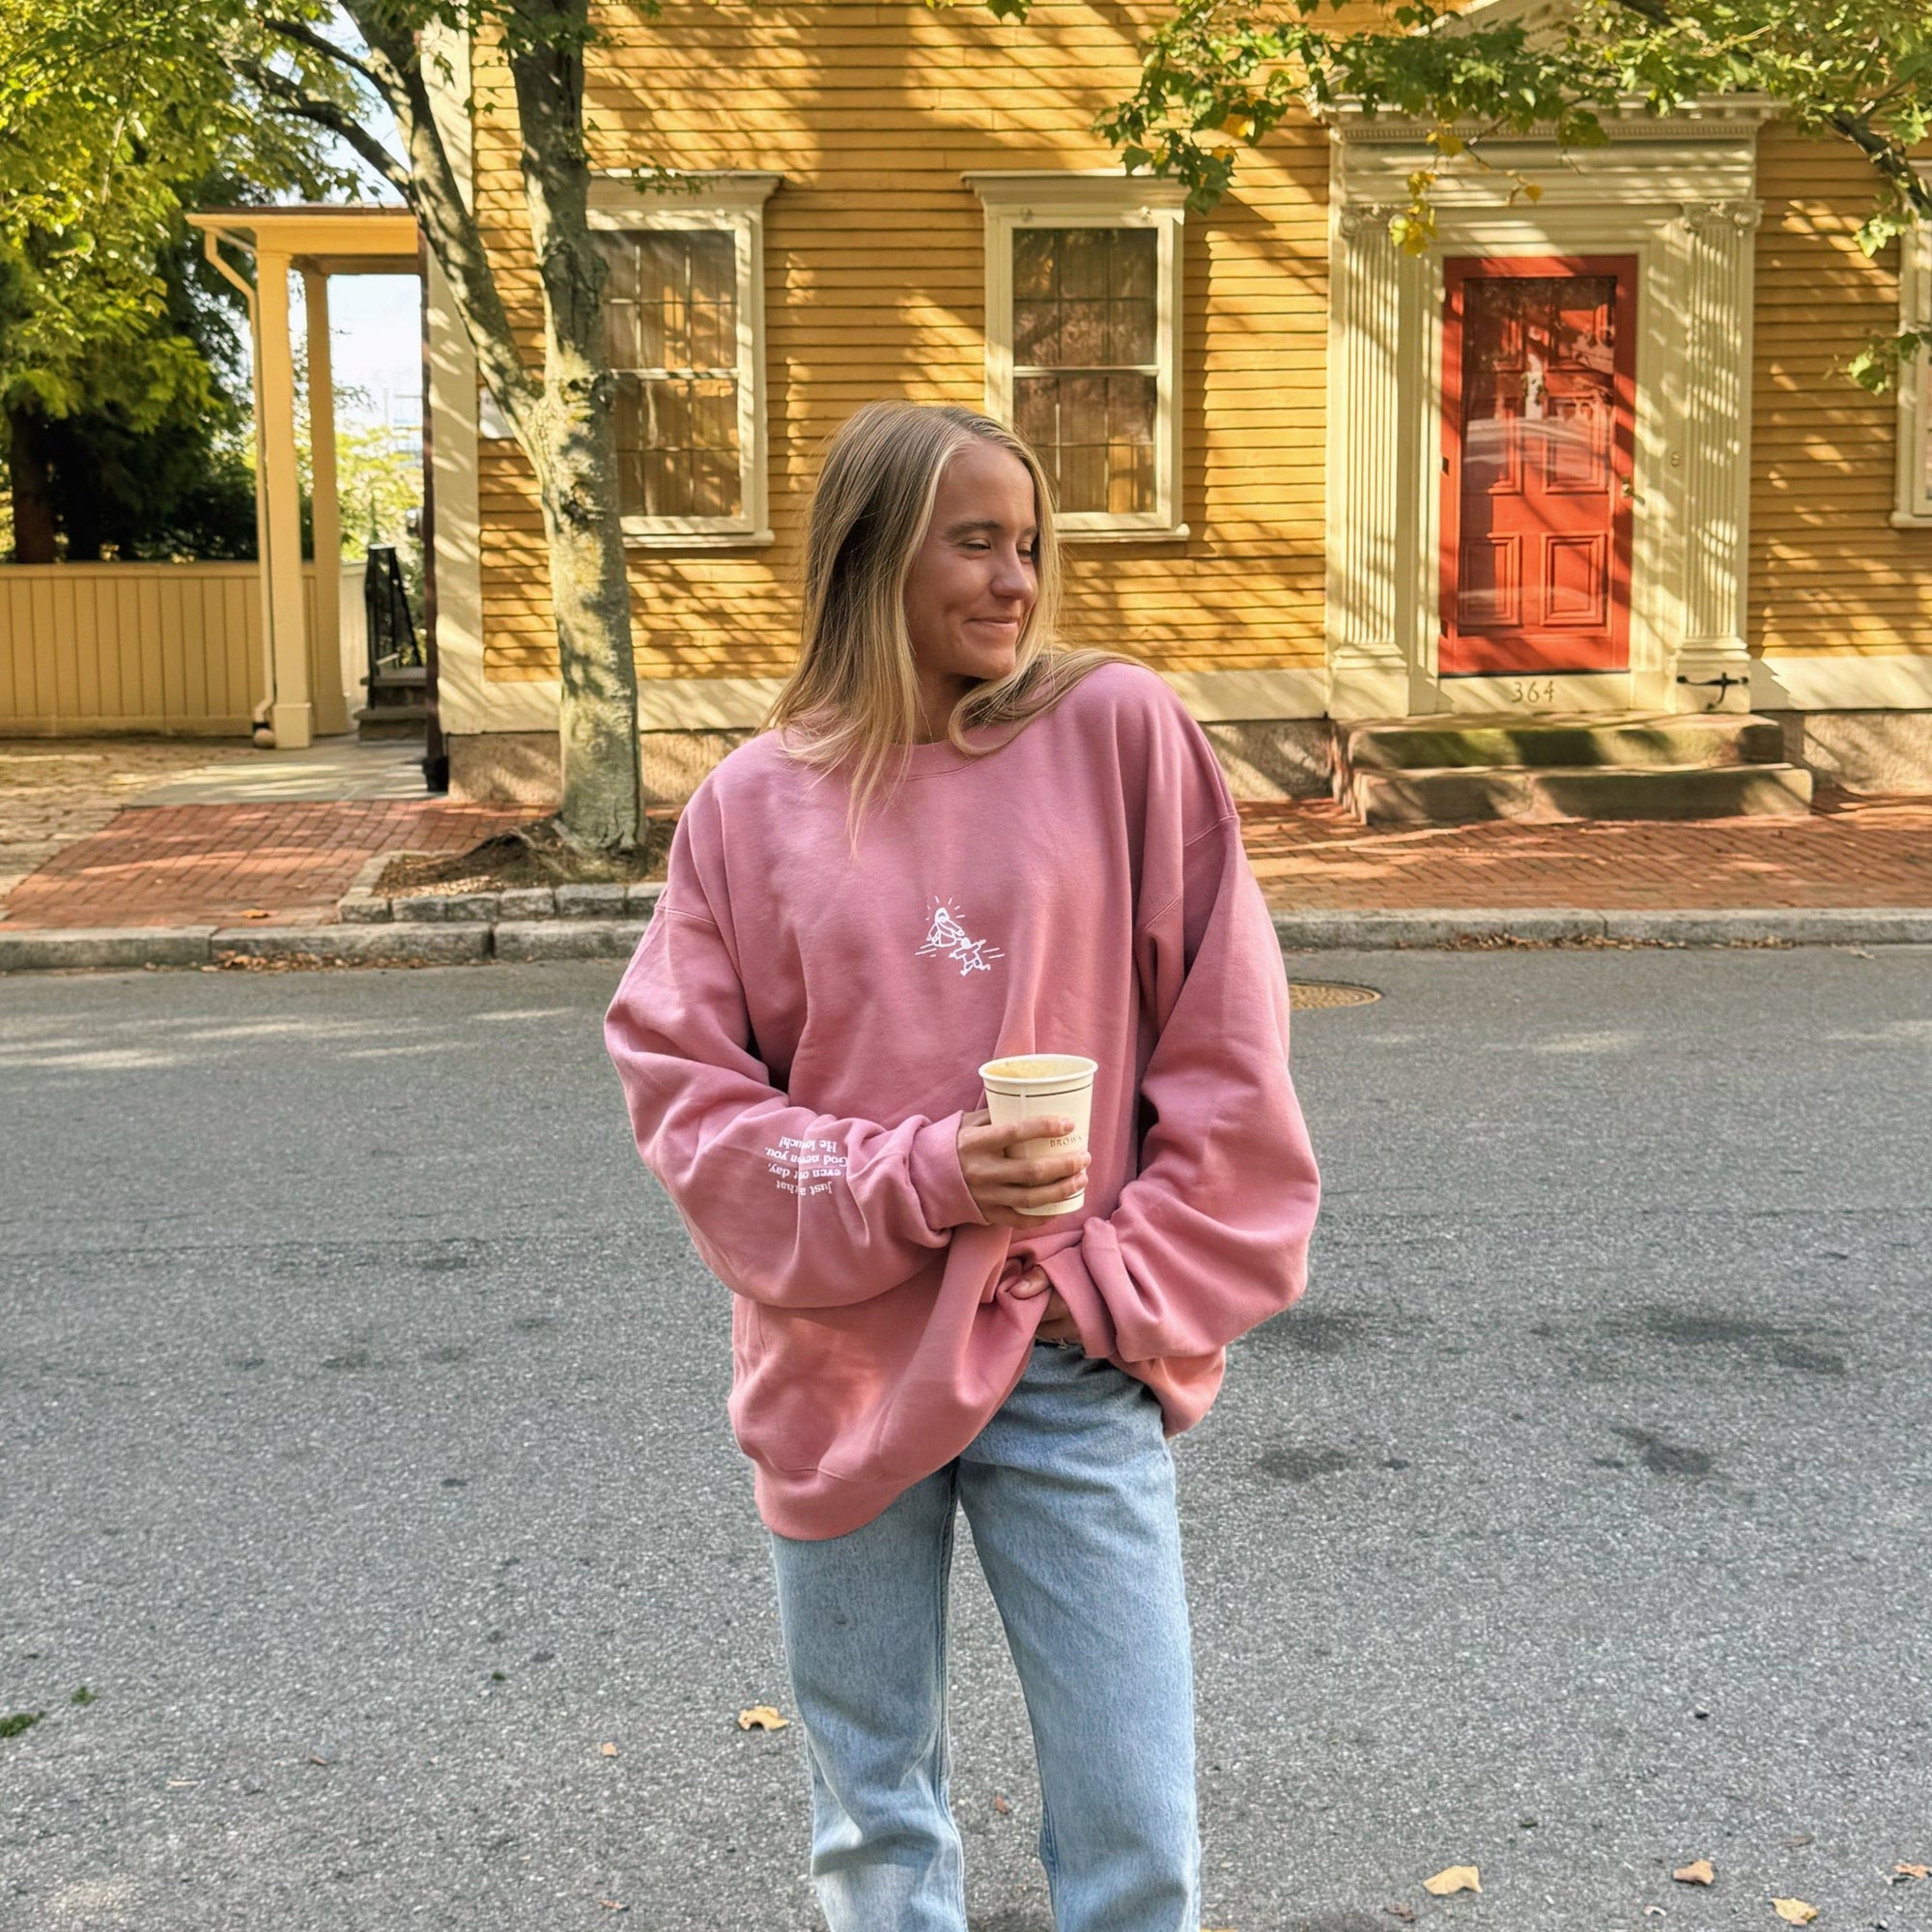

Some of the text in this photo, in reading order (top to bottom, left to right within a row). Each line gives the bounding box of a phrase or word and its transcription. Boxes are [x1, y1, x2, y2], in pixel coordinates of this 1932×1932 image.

[1512, 680, 1555, 703] 364
[818, 1140, 838, 1152] He
[765, 1147, 788, 1160] you.
[823, 1154, 848, 1167] God
[768, 1163, 790, 1179] day,
[812, 1169, 841, 1178] even
[810, 1180, 833, 1196] just
